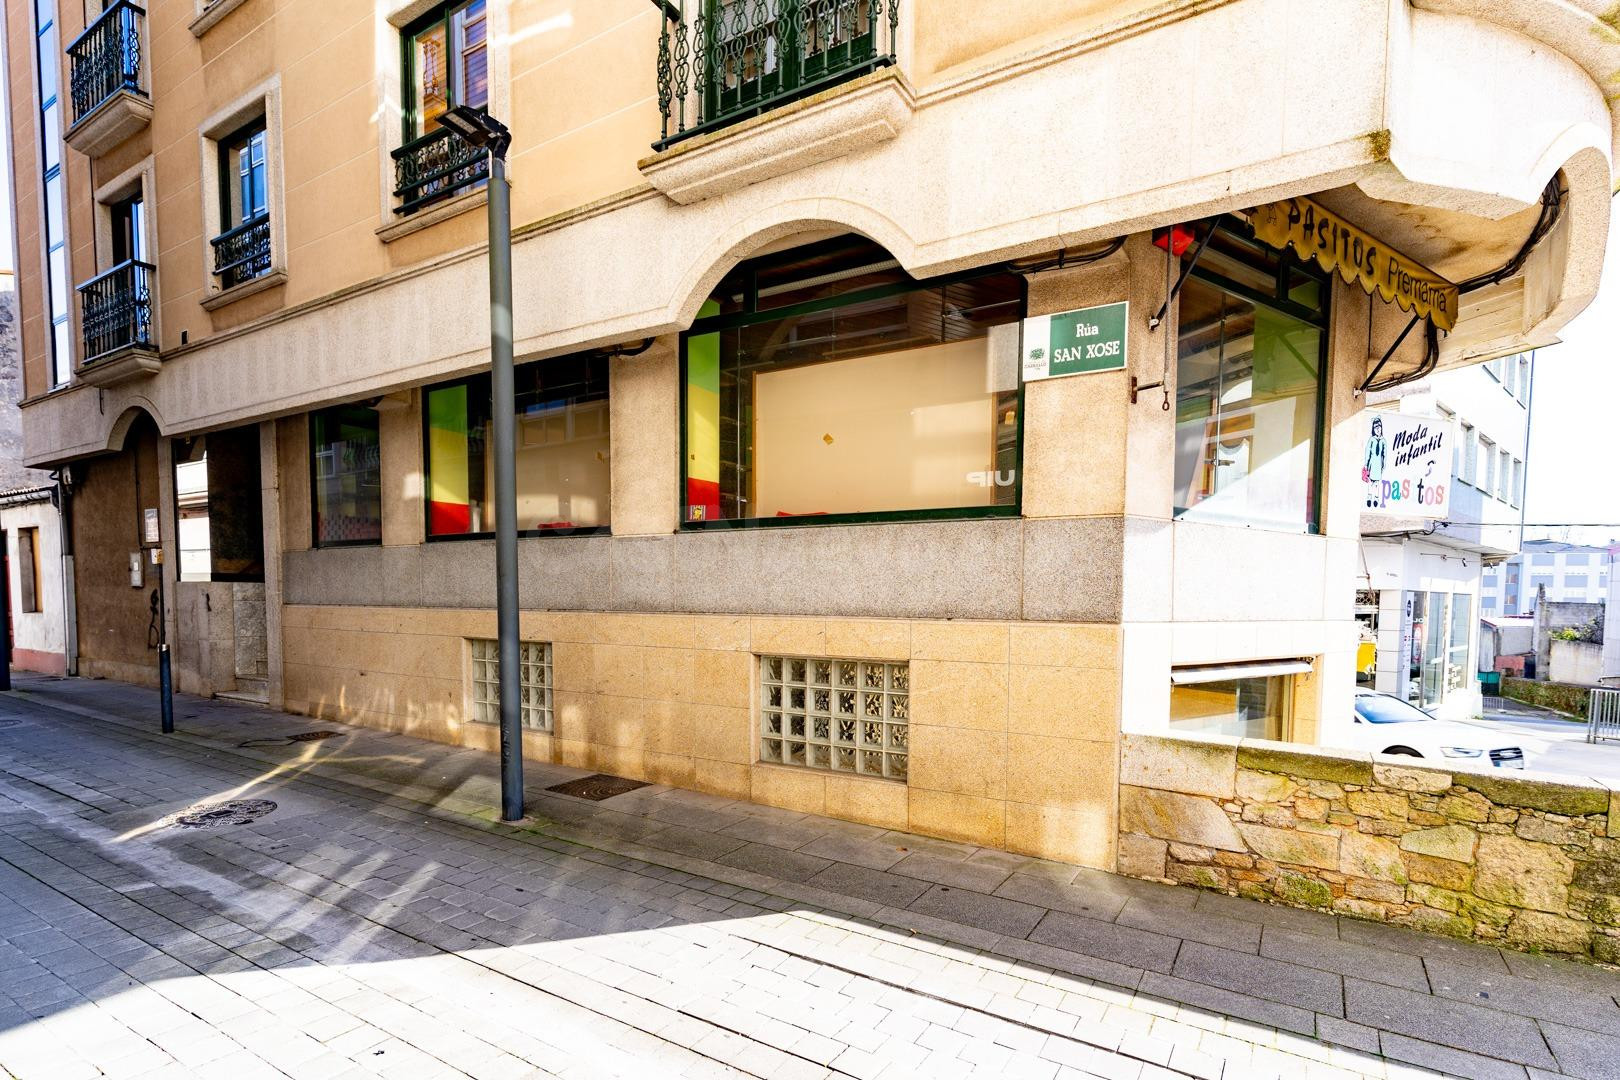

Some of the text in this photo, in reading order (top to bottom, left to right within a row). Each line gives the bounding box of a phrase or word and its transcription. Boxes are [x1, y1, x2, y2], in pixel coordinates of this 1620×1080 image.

[1288, 198, 1377, 276] PASITOS
[1076, 323, 1099, 338] Rúa
[1053, 340, 1120, 363] SAN XOSE
[1392, 424, 1428, 451] Moda
[1395, 432, 1443, 467] infantil
